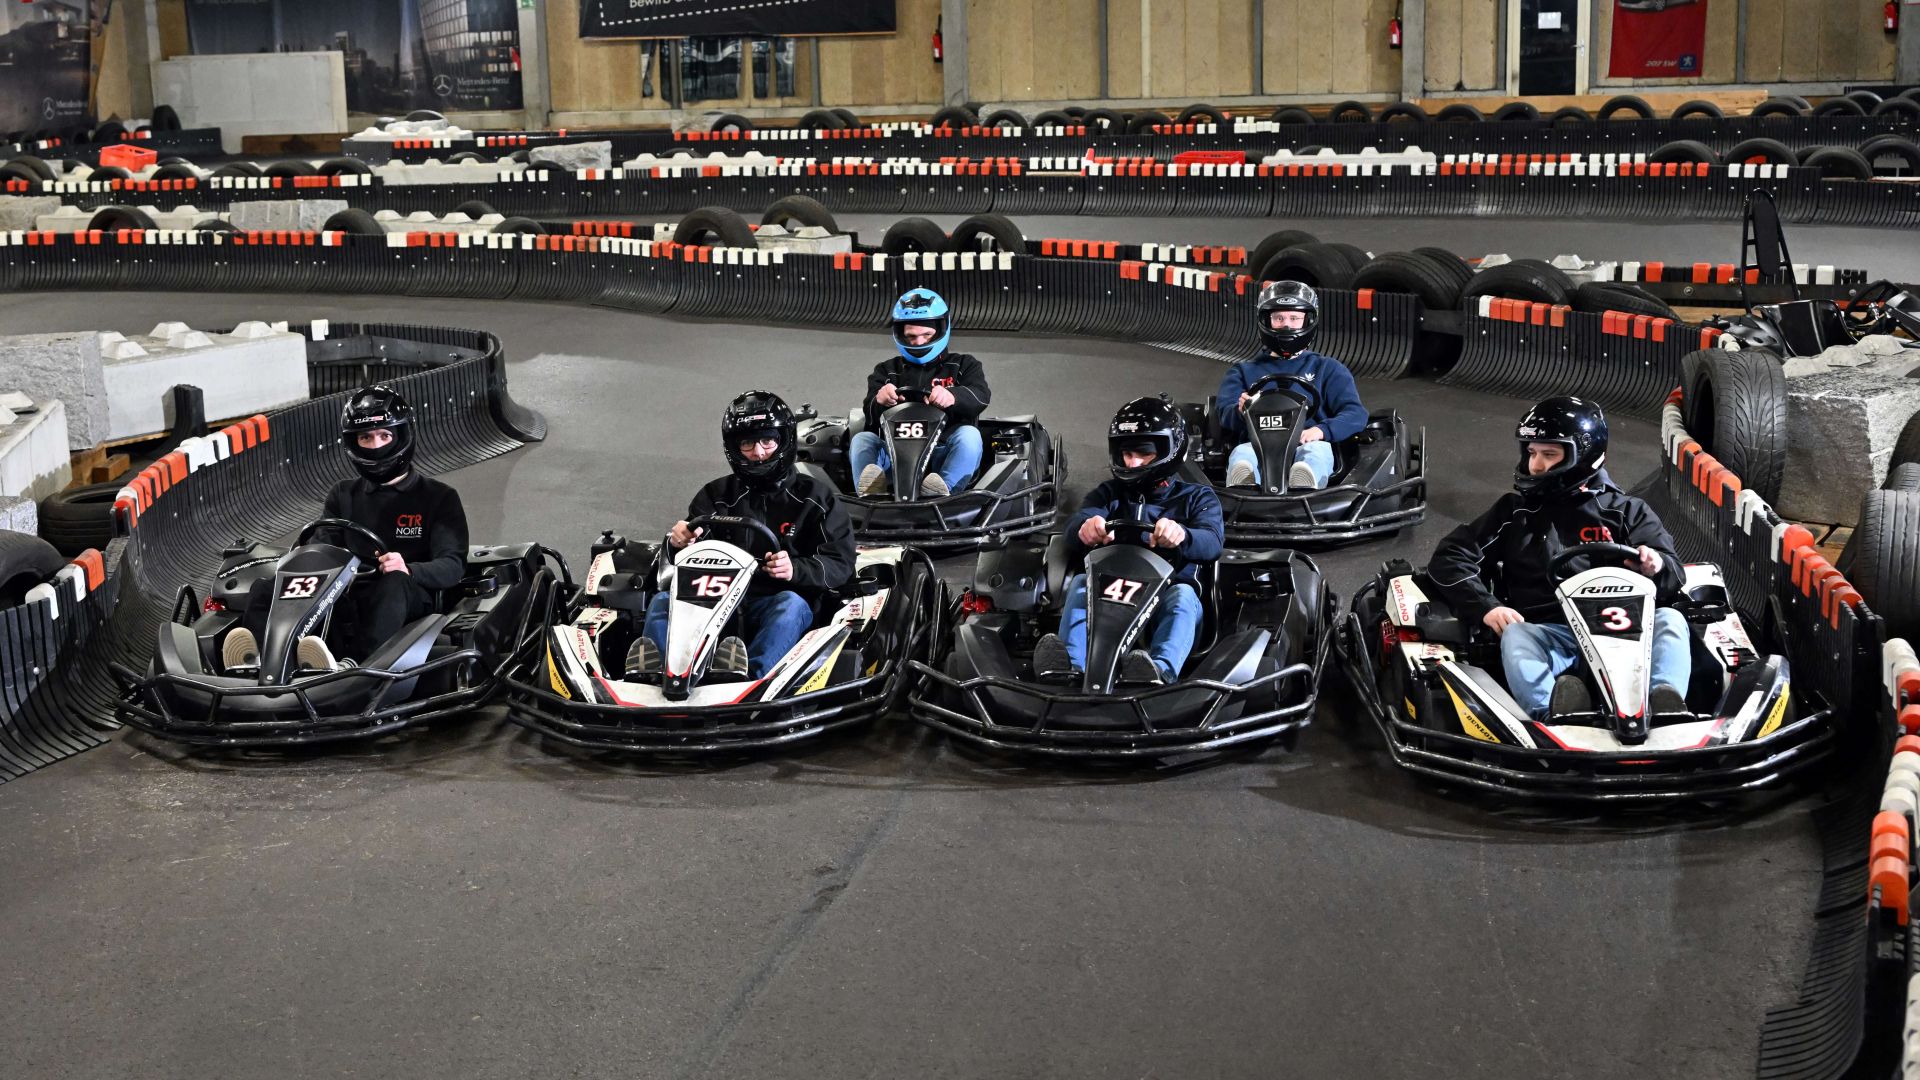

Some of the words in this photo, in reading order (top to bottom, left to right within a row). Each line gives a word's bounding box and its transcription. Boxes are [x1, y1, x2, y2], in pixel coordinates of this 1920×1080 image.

[898, 422, 924, 438] 56
[1260, 416, 1282, 427] 45
[395, 527, 422, 536] NORTE
[396, 514, 422, 527] CTR
[1579, 526, 1614, 543] CTR
[284, 577, 319, 597] 53
[691, 575, 732, 597] 15
[1103, 578, 1143, 603] 47
[715, 587, 741, 630] KARTLAND
[1393, 578, 1410, 622] KARTLAND
[1601, 606, 1633, 631] 3
[1571, 616, 1594, 663] KARTLAND
[553, 671, 569, 696] DUNLOP
[804, 666, 828, 692] DUNLOP
[1466, 714, 1495, 742] DUNLOP
